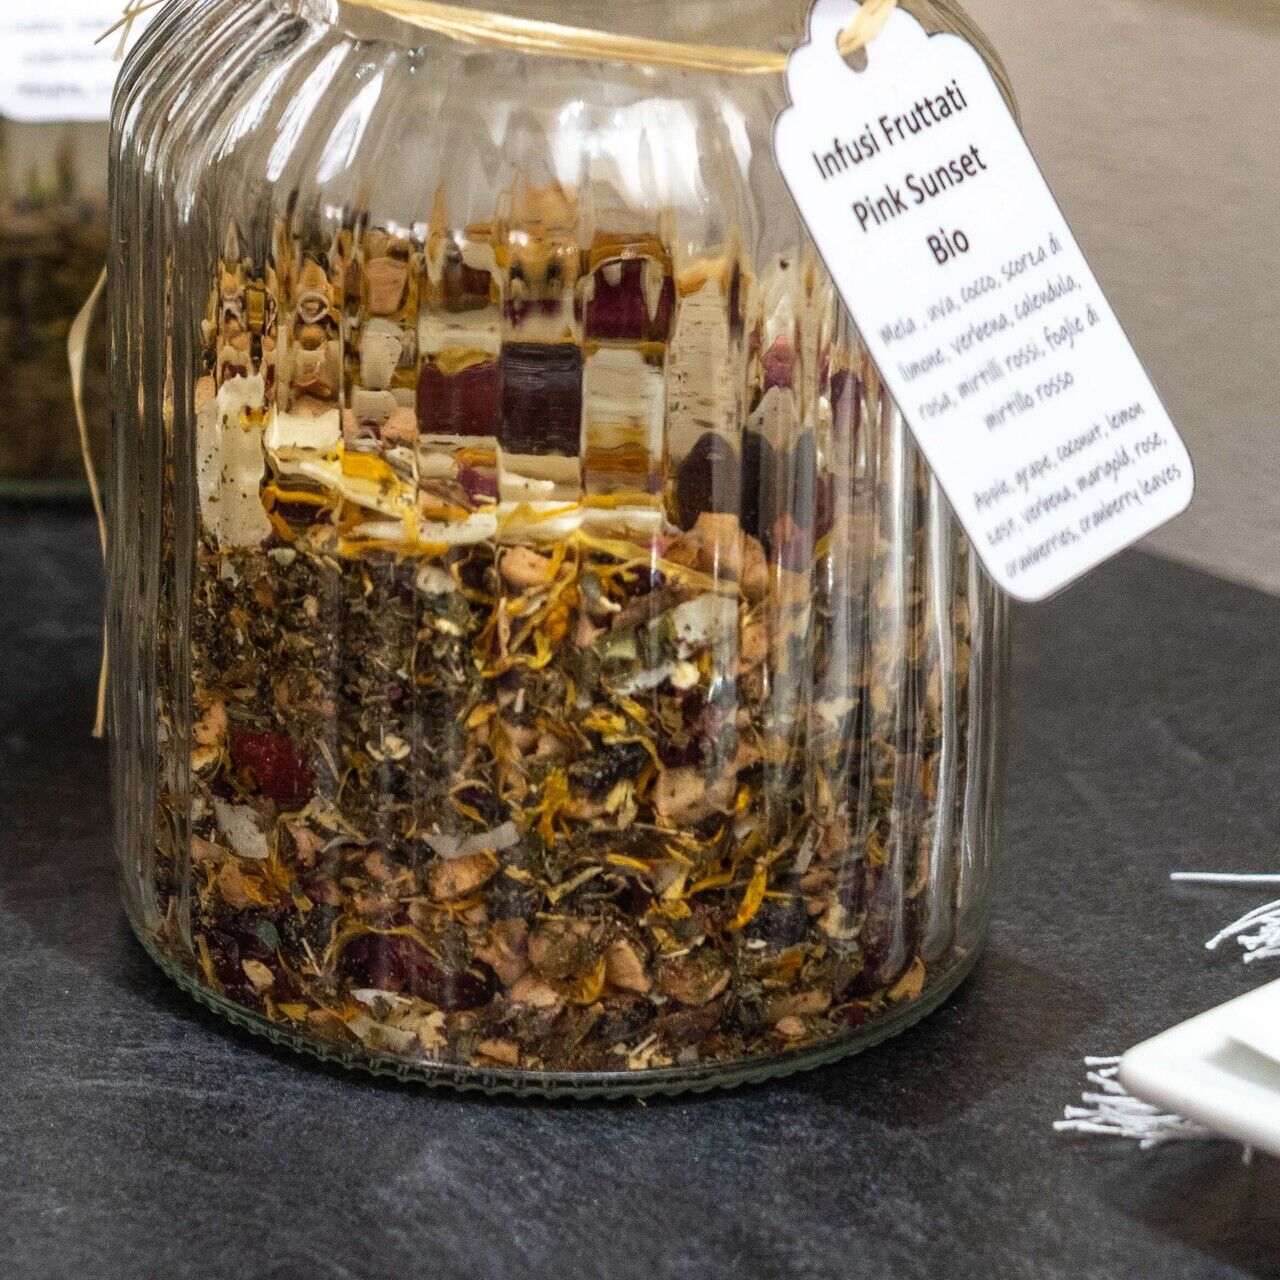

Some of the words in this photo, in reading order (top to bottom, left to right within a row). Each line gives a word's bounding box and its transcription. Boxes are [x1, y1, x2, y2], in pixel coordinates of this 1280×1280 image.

[812, 123, 880, 179] Infusi
[878, 79, 967, 145] Fruttati
[852, 185, 908, 232] Pink
[904, 144, 987, 204] Sunset
[926, 228, 969, 265] Bio
[1001, 245, 1048, 282] scorza
[957, 358, 1005, 399] mirtilli
[1043, 316, 1084, 351] foglie
[983, 391, 1035, 431] mirtillo
[1035, 371, 1074, 401] rosso
[1105, 402, 1145, 431] lemon
[1079, 489, 1143, 535] cranberry
[1137, 463, 1181, 496] leaves
